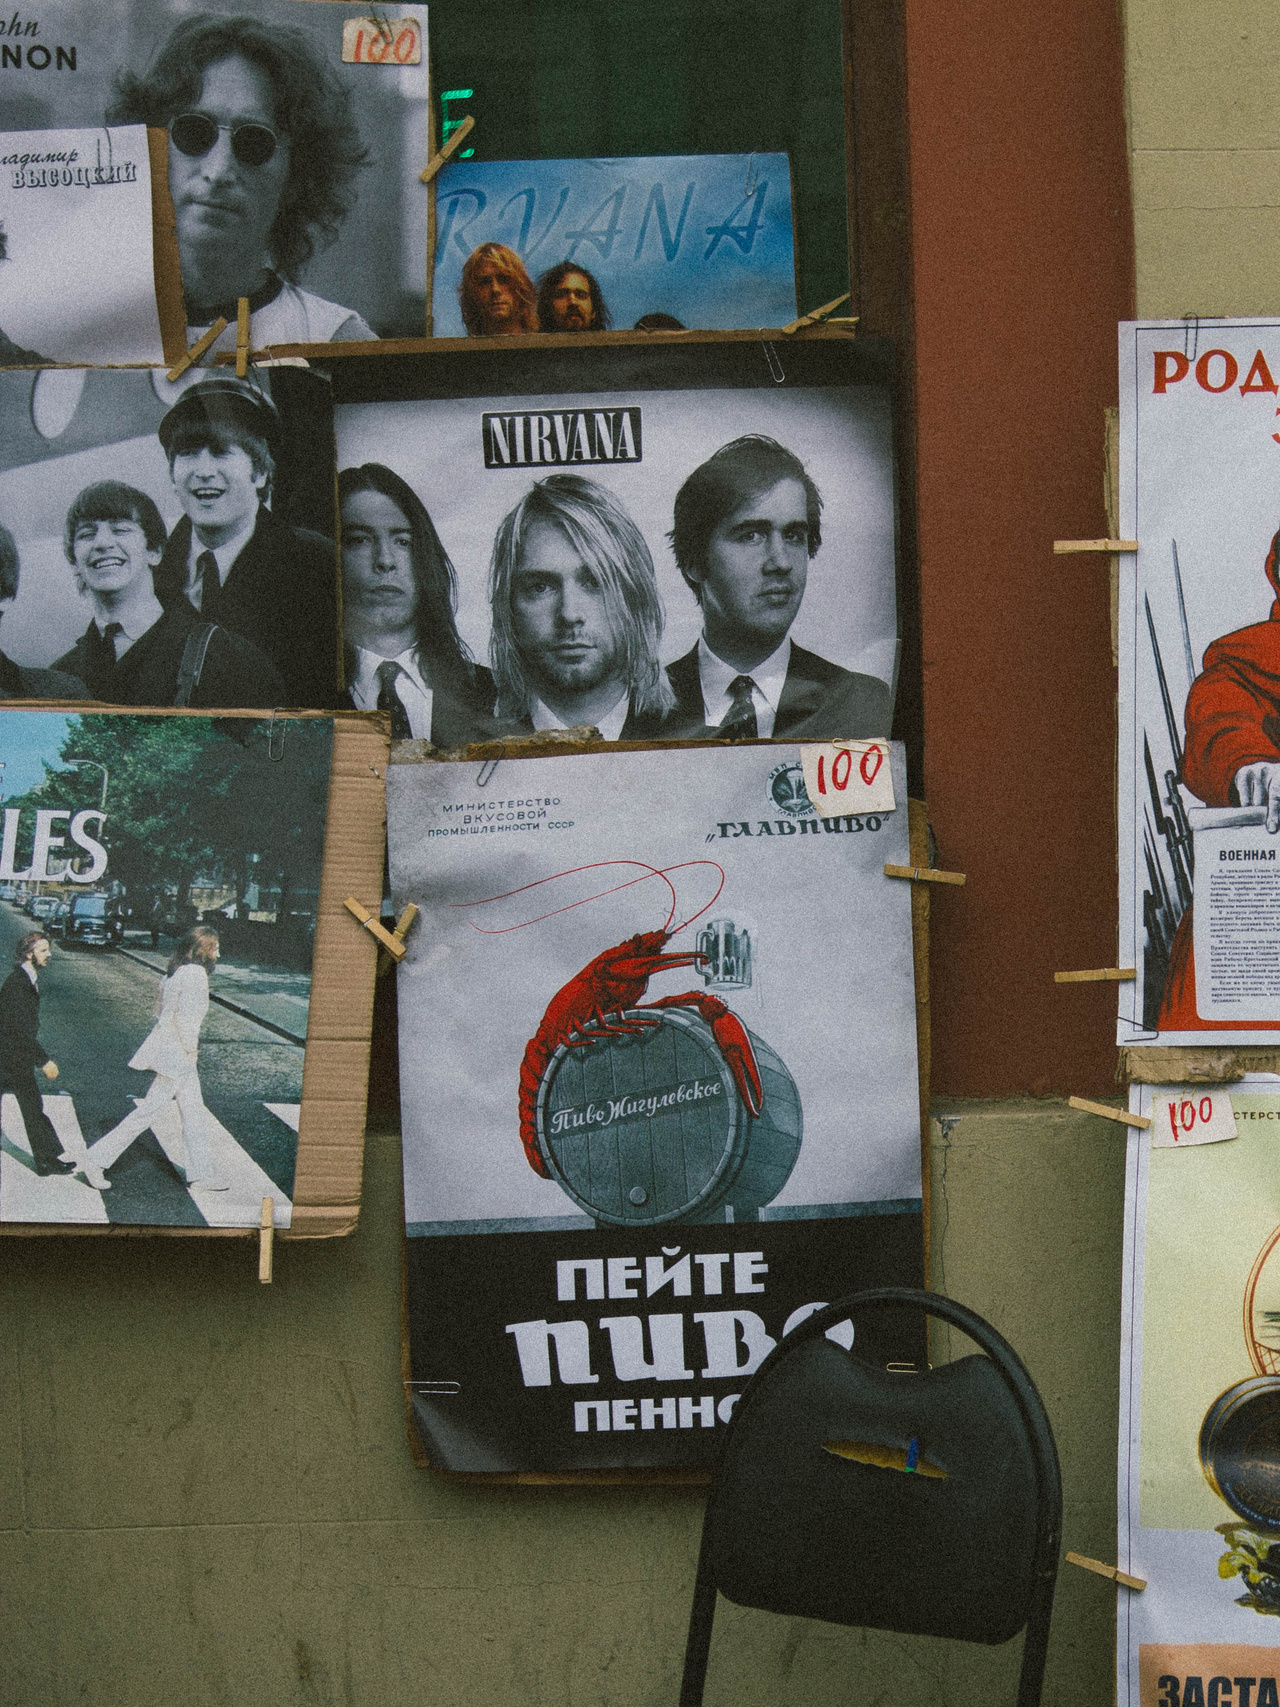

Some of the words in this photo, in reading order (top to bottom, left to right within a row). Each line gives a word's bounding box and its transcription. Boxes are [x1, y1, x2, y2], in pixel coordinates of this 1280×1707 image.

[2, 44, 77, 71] NON
[353, 29, 416, 63] 100
[12, 161, 137, 189] ВЫСОЦКИЙ
[488, 411, 639, 466] NIRVANA
[817, 745, 883, 794] 100
[442, 797, 561, 813] МИНИСТЕРСТВО
[463, 808, 547, 824] ВКУСОВОЙ
[0, 808, 108, 883] LES
[428, 822, 540, 838] ПРОМЫШЛЕННОСТИ
[548, 821, 575, 830] СССР
[1219, 849, 1276, 861] ВОЕННАЯ
[551, 1104, 604, 1133] Пиво
[602, 1081, 721, 1125] Жигулевское
[1168, 1096, 1213, 1141] 100
[556, 1246, 769, 1301] ПЕЙТЕ
